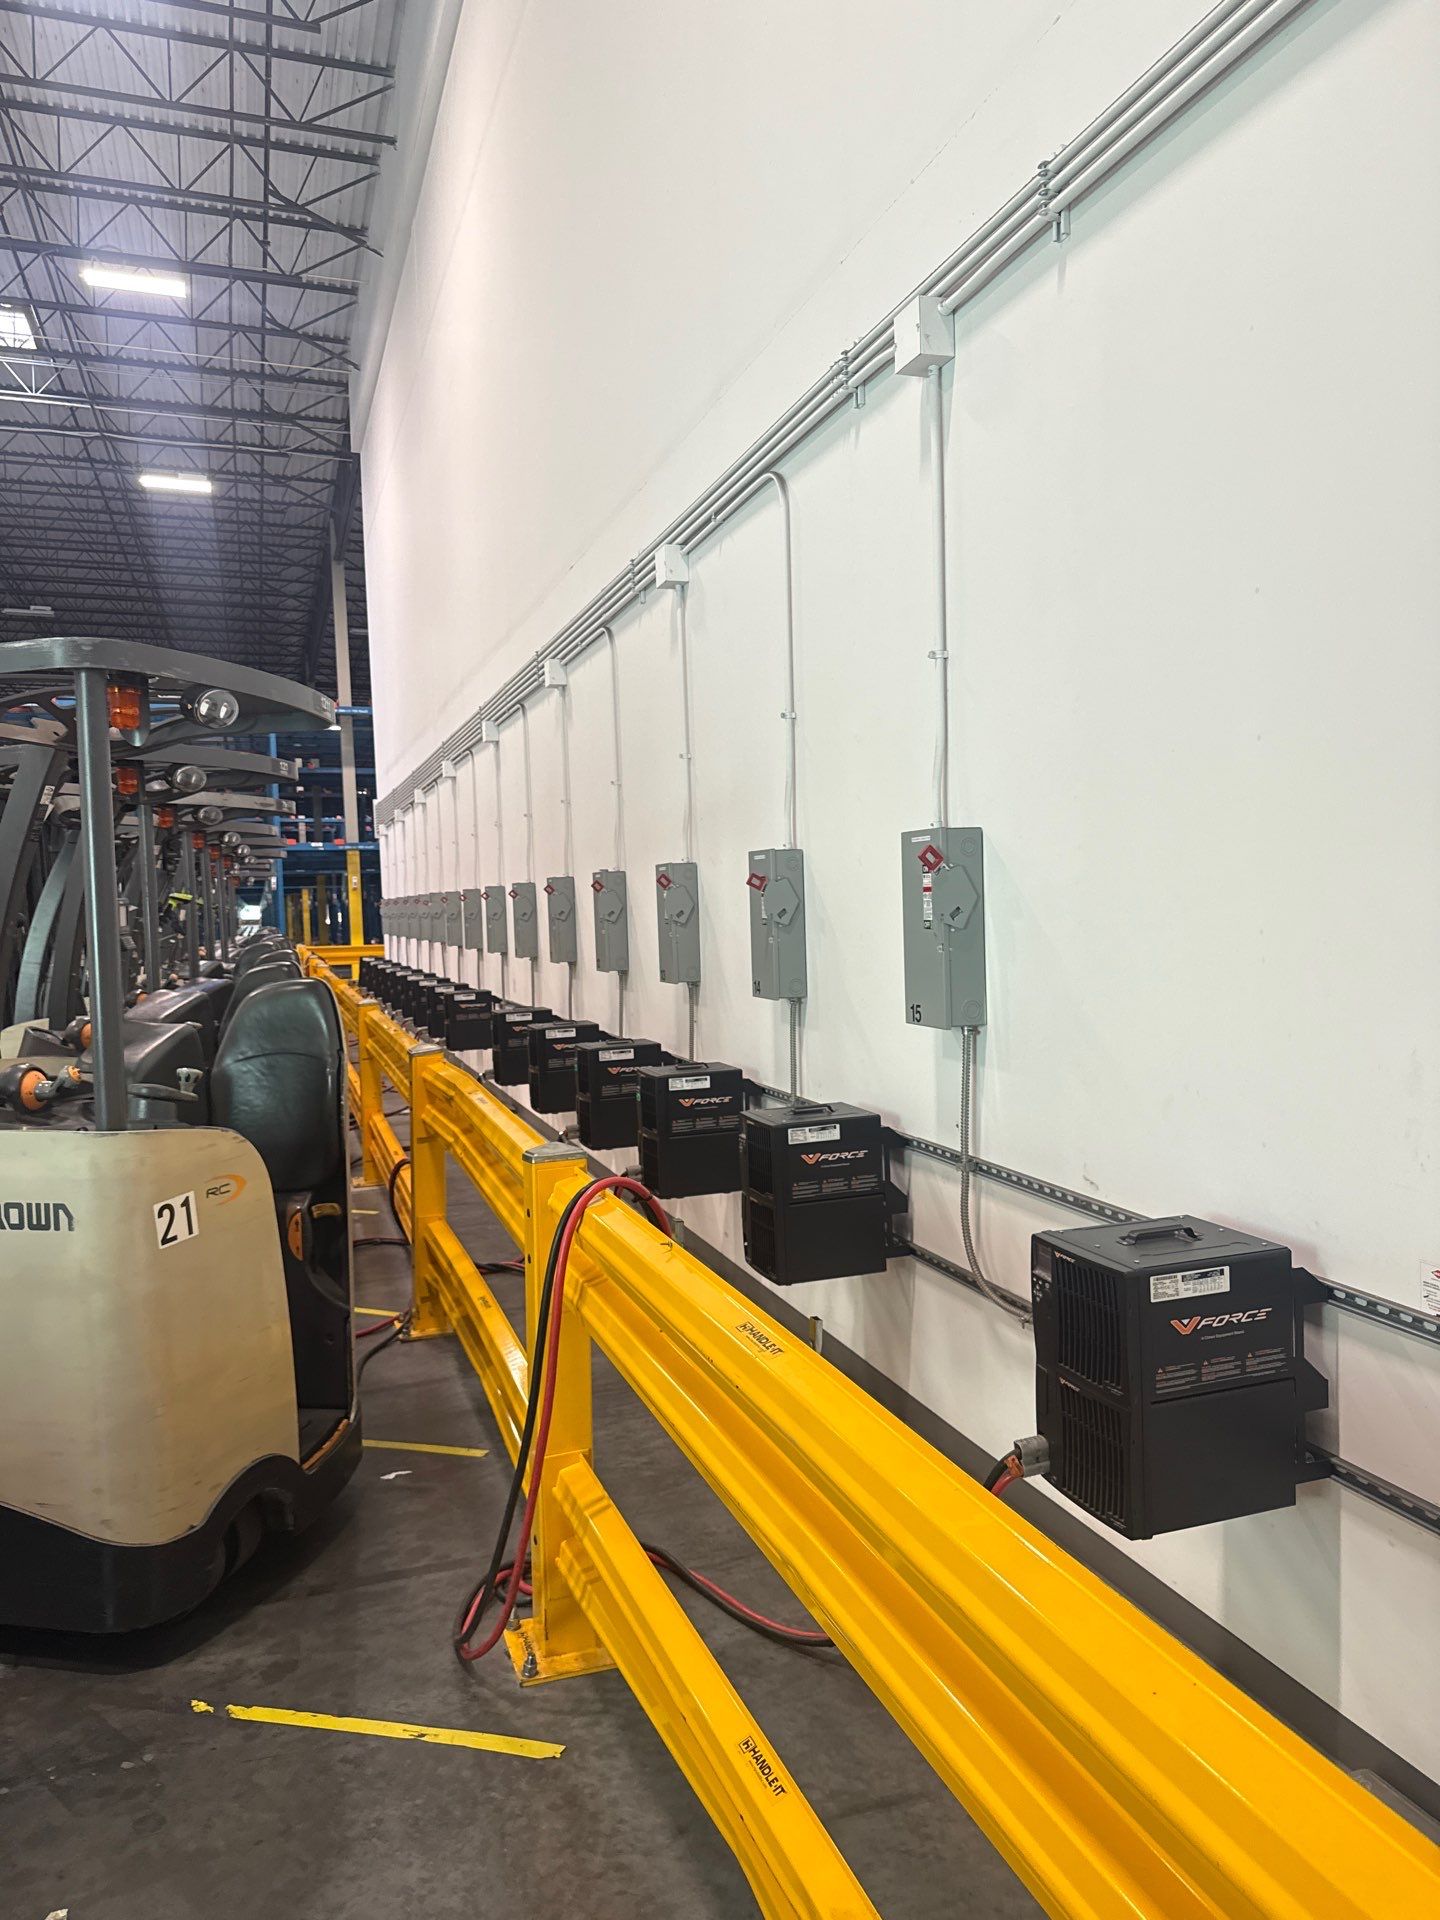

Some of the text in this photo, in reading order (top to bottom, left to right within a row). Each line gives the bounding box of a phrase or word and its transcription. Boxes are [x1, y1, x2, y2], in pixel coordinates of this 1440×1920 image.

[753, 980, 761, 995] 14
[910, 1003, 922, 1023] 15
[206, 1183, 231, 1199] RC
[0, 1202, 75, 1232] OWN
[157, 1196, 194, 1246] 21
